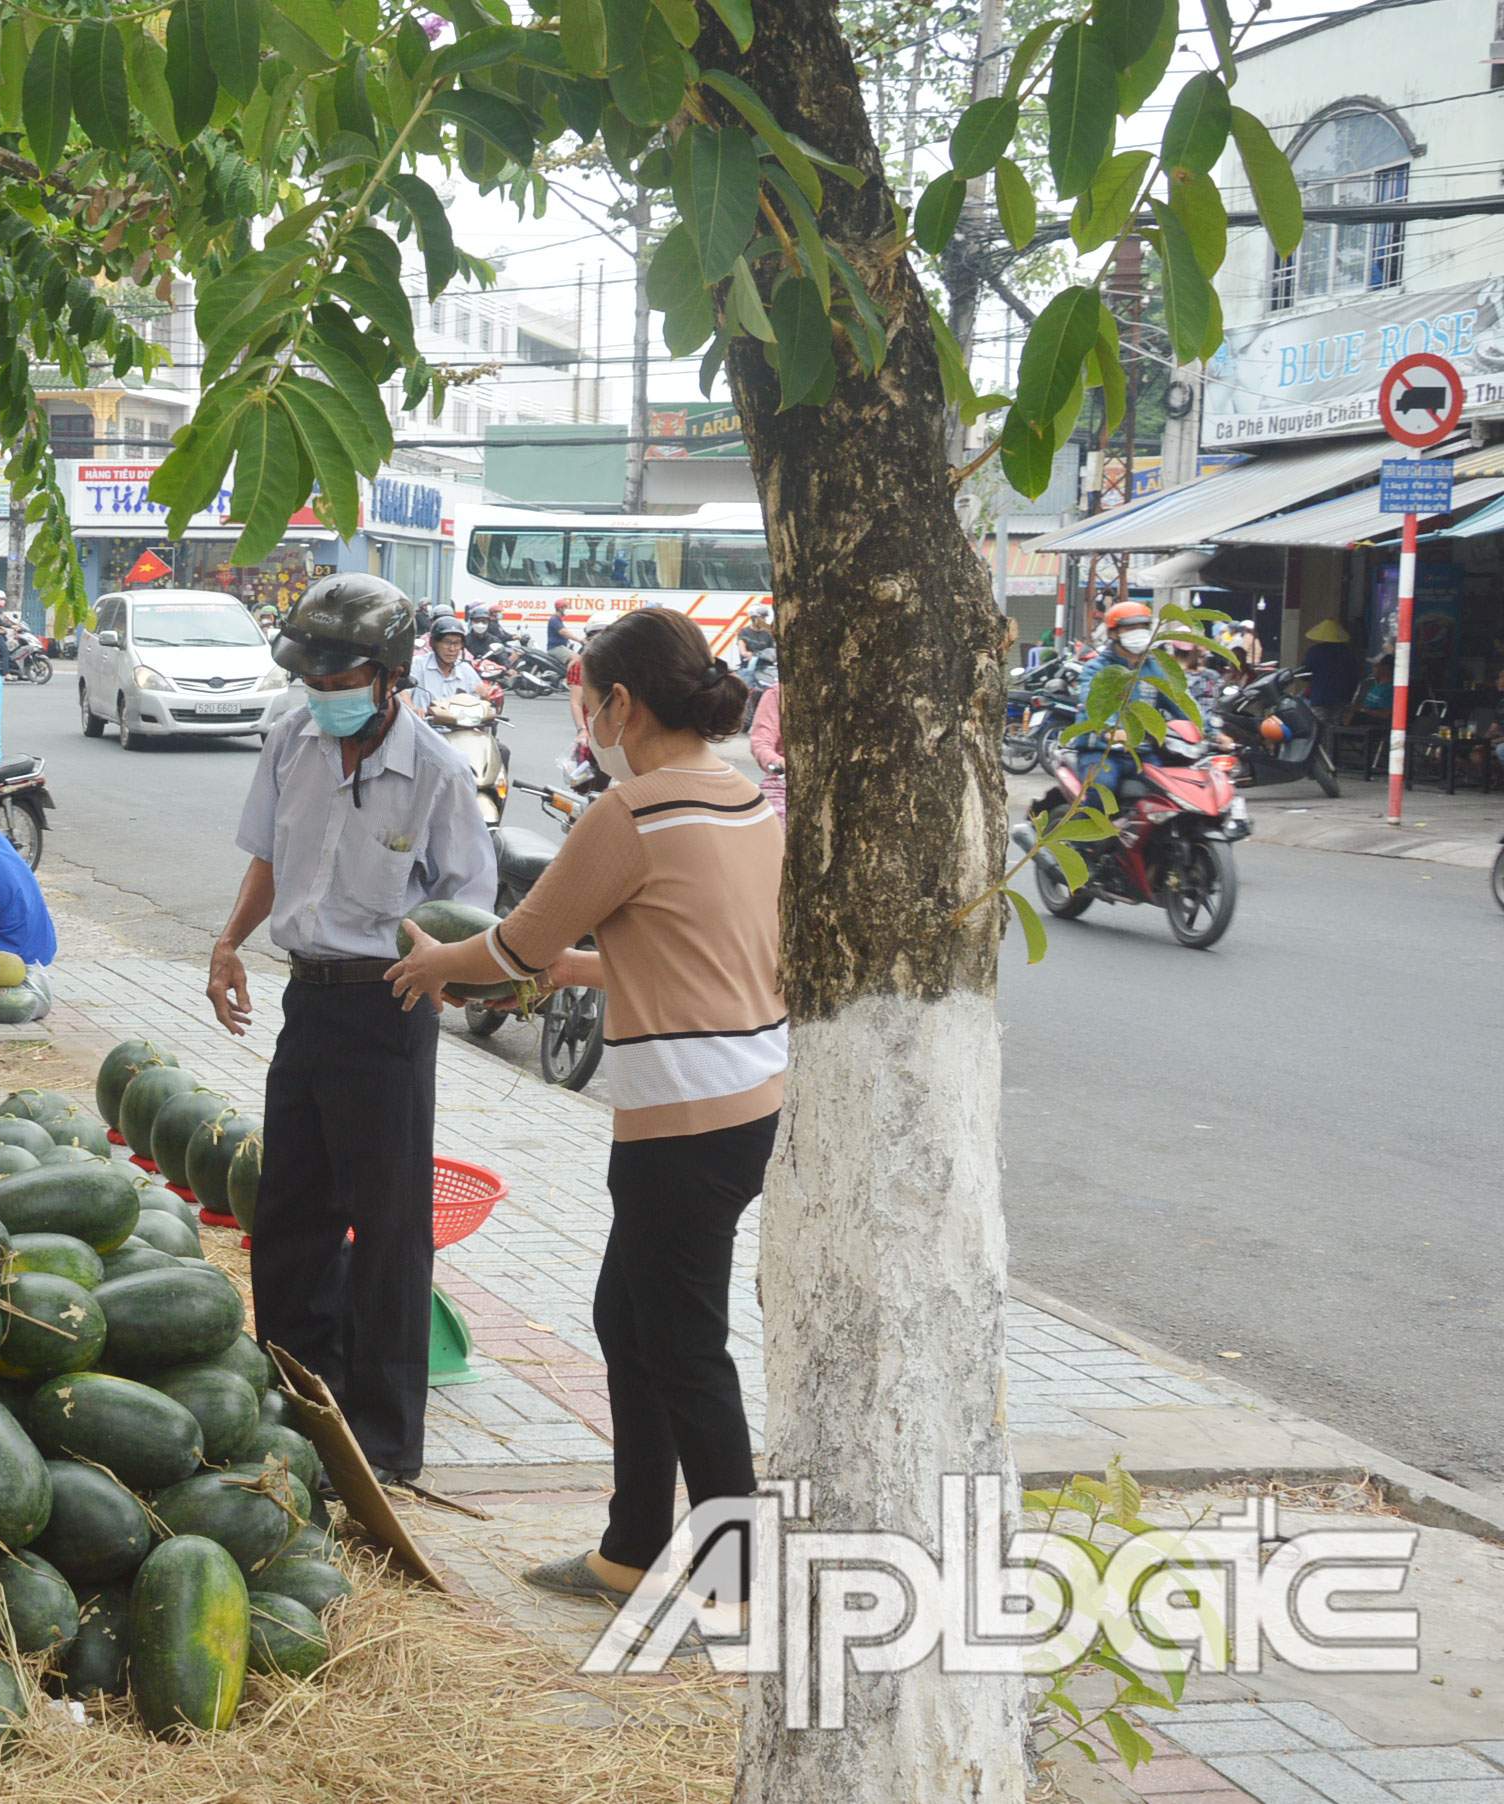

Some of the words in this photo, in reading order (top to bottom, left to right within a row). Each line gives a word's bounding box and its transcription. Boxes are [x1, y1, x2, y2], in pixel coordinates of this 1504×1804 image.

[1278, 331, 1365, 388] BLUE
[1377, 311, 1477, 369] ROSE
[1237, 416, 1263, 437] Phê
[1268, 409, 1323, 434] Nguyên
[1327, 399, 1364, 425] Chất
[85, 466, 112, 480] HÀNG
[113, 467, 135, 480] TIÊU
[138, 468, 157, 481] DÙ
